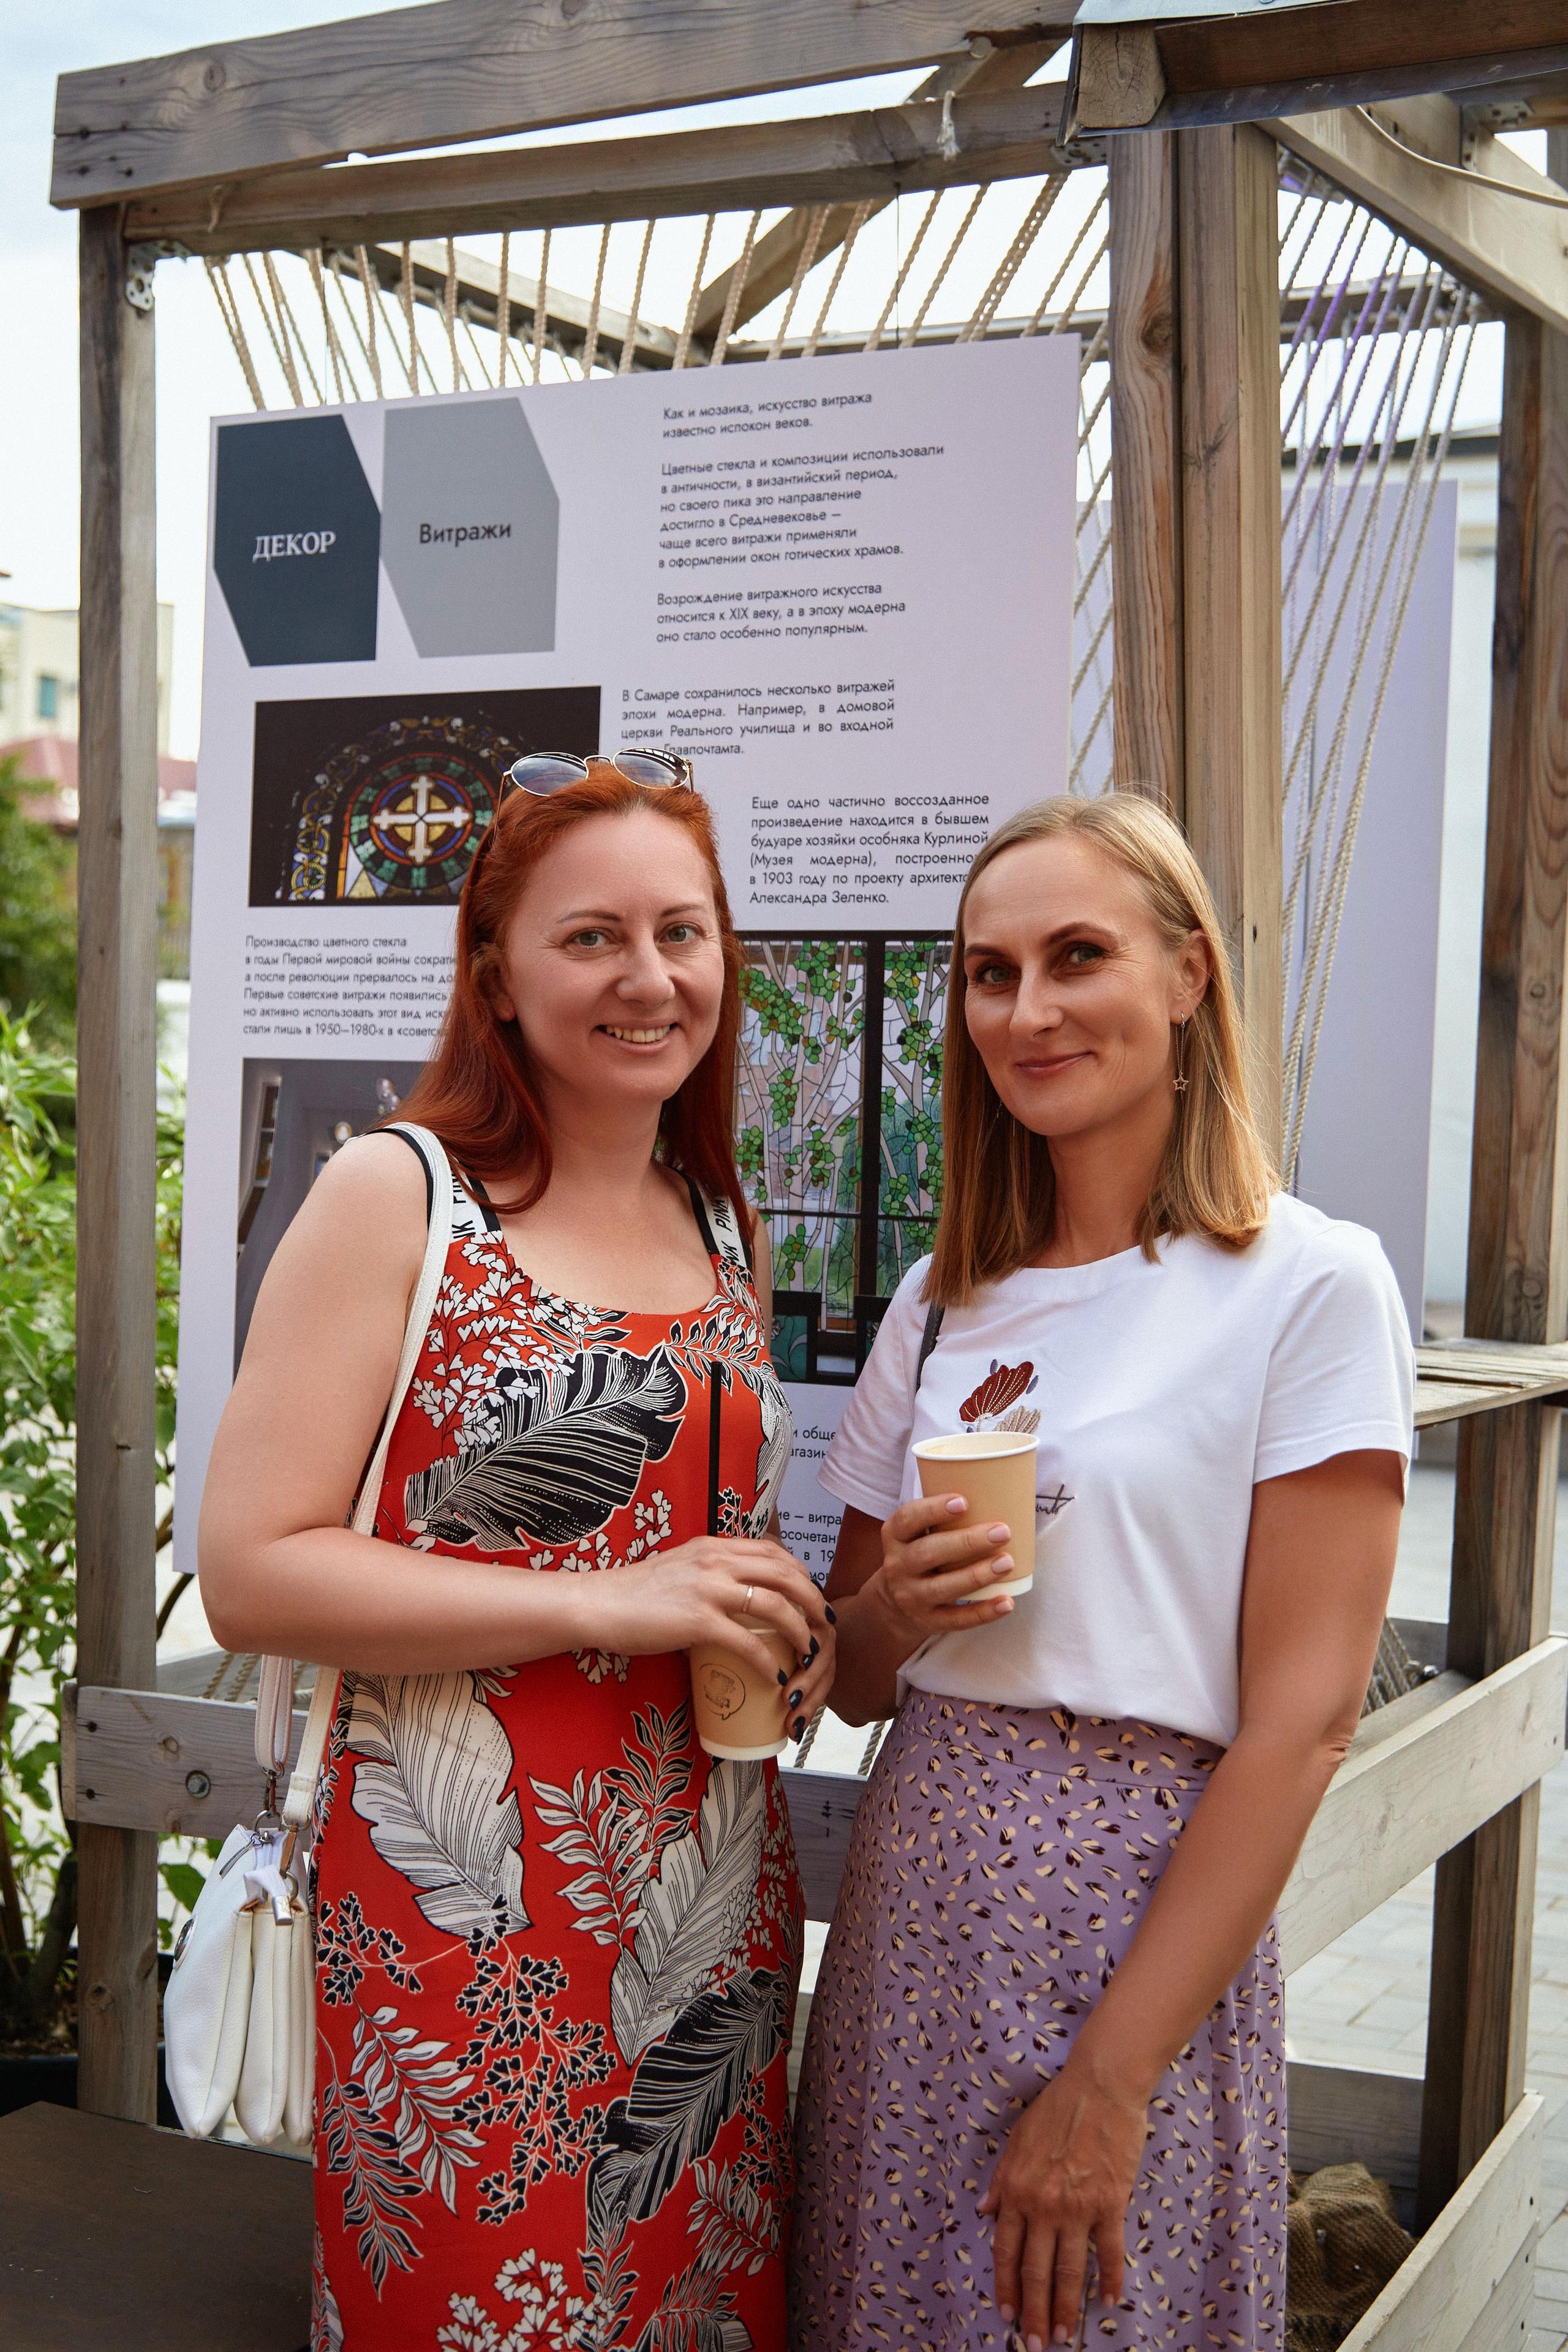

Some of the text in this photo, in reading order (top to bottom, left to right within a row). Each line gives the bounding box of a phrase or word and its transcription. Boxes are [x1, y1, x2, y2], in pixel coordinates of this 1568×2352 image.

[663, 407, 684, 420] Как
[698, 404, 753, 417] мозаика,
[758, 398, 817, 413] искусство
[821, 393, 872, 408] витража
[662, 418, 812, 438] известно испокон веков.
[661, 446, 944, 476] Цветные стекла и композиции использовали
[660, 469, 897, 494] в античности, в византийский период,
[660, 489, 862, 512] но своего пика это направление
[659, 519, 715, 532] достигло
[718, 518, 725, 527] в
[728, 511, 827, 529] Средневековье
[420, 522, 511, 547] Витражи
[658, 529, 857, 549] чаще всего витражи применяли
[252, 530, 336, 562] ДЕКОР
[658, 545, 903, 569] в оформлении окон готических храмов.
[657, 584, 882, 607] Возрождение витражного искусства
[657, 612, 715, 624] относится
[718, 611, 725, 620] к
[752, 609, 782, 620] веку,
[786, 608, 794, 617] а
[798, 607, 805, 617] в
[809, 605, 844, 617] эпоху
[847, 602, 905, 616] модерна
[656, 624, 867, 643] оно стало особенно популярным.
[622, 678, 895, 703] В Самаре сохранилось несколько витражей
[622, 698, 894, 720] эпохи модерна. Например, в домовой
[620, 717, 894, 741] церкви Реального училища и во входной
[752, 794, 989, 810] Еще одно частично воссозданное
[751, 810, 989, 831] произведение находится в бывшем
[750, 831, 988, 850] будуаре хозяйки особняка Курлиной
[750, 850, 978, 869] (Музея модерна), построенно
[749, 875, 756, 884] в
[762, 871, 793, 884] 1903
[799, 875, 826, 888] году
[832, 874, 848, 884] по
[854, 874, 904, 887] проекту
[748, 890, 889, 907] Александра Зеленко.
[245, 935, 407, 949] Производство цветного стекла
[244, 956, 251, 965] в
[254, 956, 279, 965] годы
[282, 952, 322, 966] Первой
[325, 952, 372, 967] мировой
[376, 953, 410, 965] войны
[244, 973, 251, 982] а
[254, 973, 285, 982] после
[288, 973, 349, 984] революции
[353, 973, 417, 984] прервалось
[421, 974, 434, 982] на
[243, 987, 447, 1002] Первые советские витражи появились
[243, 1008, 257, 1016] но
[259, 1008, 300, 1017] активно
[303, 1008, 374, 1018] использовать
[377, 1009, 398, 1018] этот
[401, 1009, 421, 1019] вид
[243, 1025, 271, 1034] стали
[273, 1025, 302, 1035] лишь
[305, 1026, 311, 1035] в
[387, 1027, 393, 1036] в
[809, 1513, 842, 1527] витра
[781, 1531, 838, 1544] осочетан
[821, 1550, 834, 1562] 19
